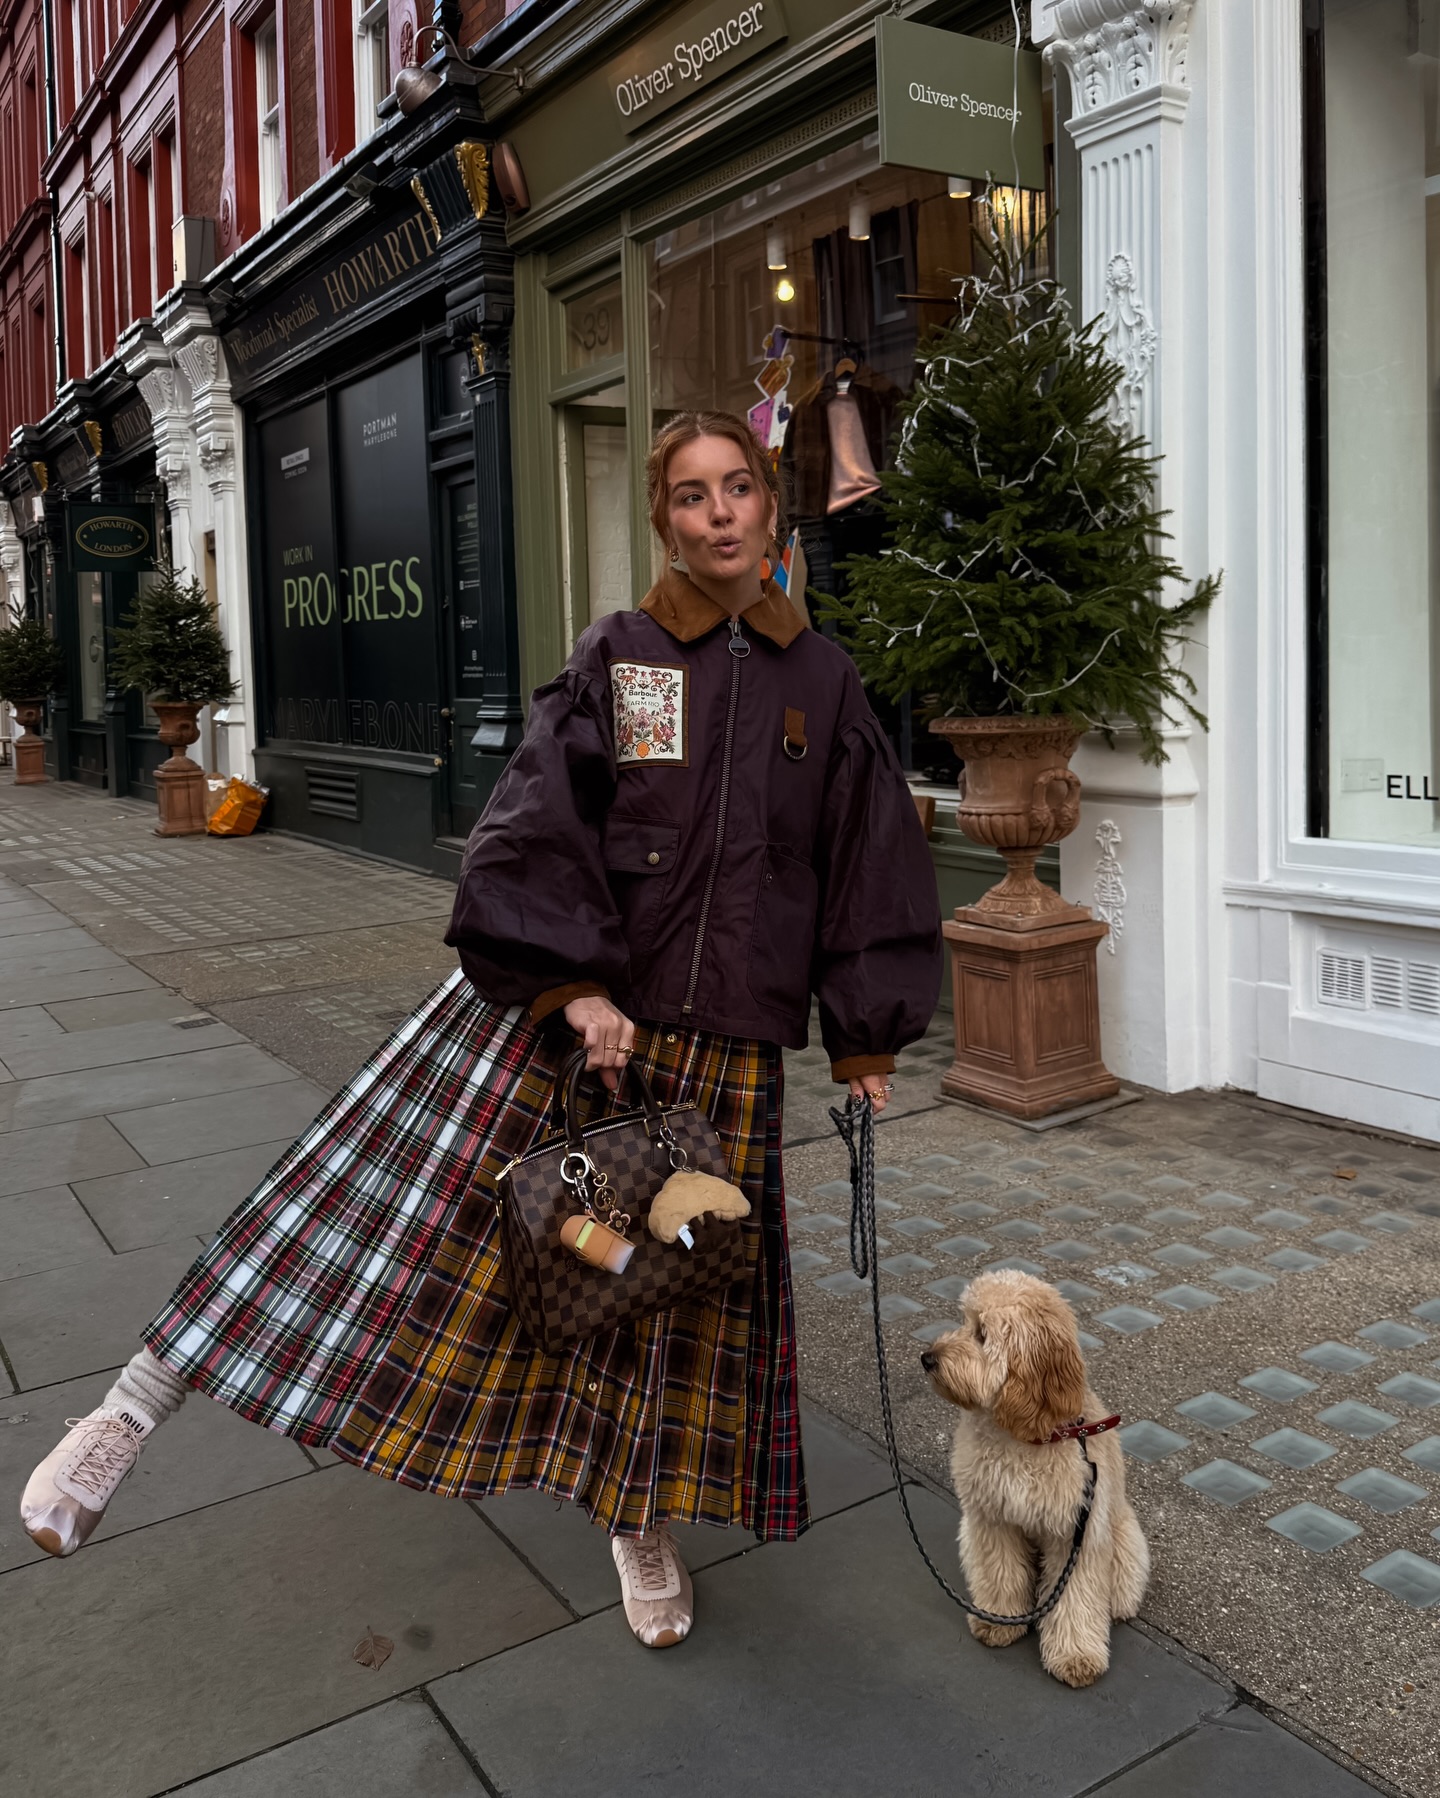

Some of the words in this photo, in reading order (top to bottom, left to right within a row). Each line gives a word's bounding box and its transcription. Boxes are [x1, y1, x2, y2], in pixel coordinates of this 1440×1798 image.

[616, 61, 673, 116] Oliver
[674, 2, 764, 82] Spencer
[909, 82, 958, 109] Oliver
[960, 93, 1022, 122] Spencer
[231, 317, 277, 365] Woodwind
[274, 294, 320, 341] Specialist
[583, 307, 610, 351] 39
[363, 412, 397, 437] PORTMAN
[363, 428, 397, 447] MARYLEBONE
[89, 521, 134, 532] HOWARTH
[94, 542, 133, 553] LONDON
[282, 546, 304, 567] WORK
[304, 544, 313, 562] IN
[283, 556, 423, 628] PROGRESS
[1387, 775, 1439, 801] ELL
